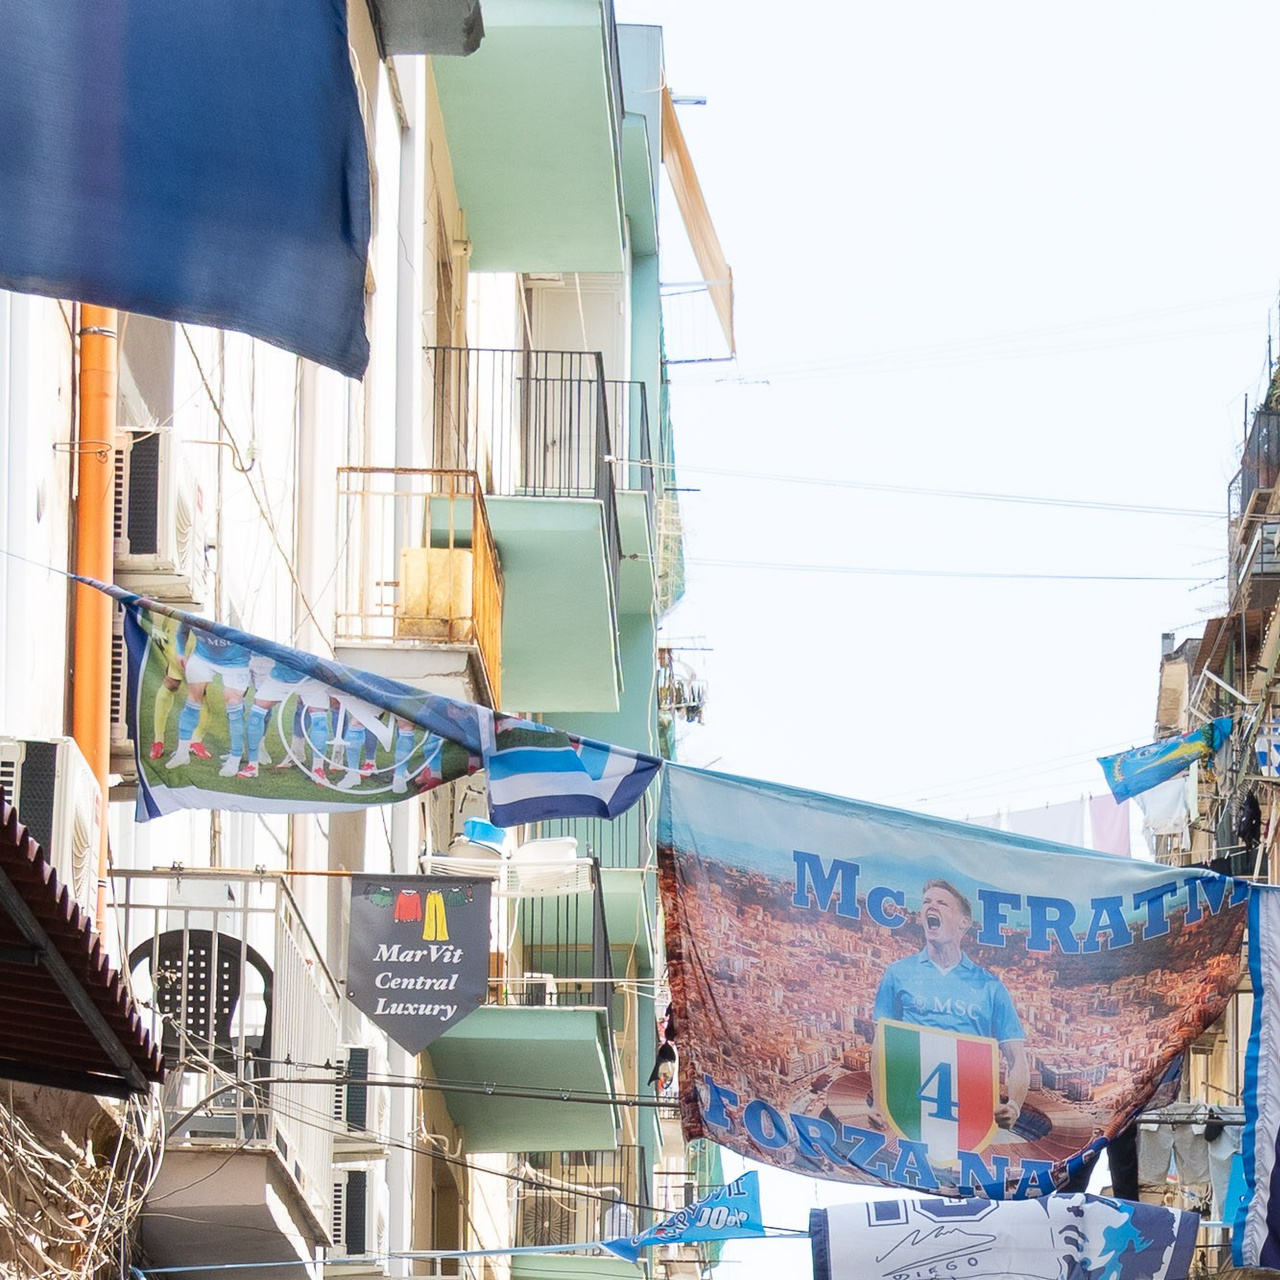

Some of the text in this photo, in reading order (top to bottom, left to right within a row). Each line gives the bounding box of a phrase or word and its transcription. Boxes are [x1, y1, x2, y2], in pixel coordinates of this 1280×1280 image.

[792, 849, 907, 929] Mc
[373, 943, 464, 963] MarVit
[374, 972, 459, 991] Central
[374, 997, 458, 1021] Luxury
[932, 996, 981, 1021] MSC
[915, 1062, 961, 1122] 4
[701, 1073, 941, 1191] FORZA
[694, 1205, 749, 1230] 00%
